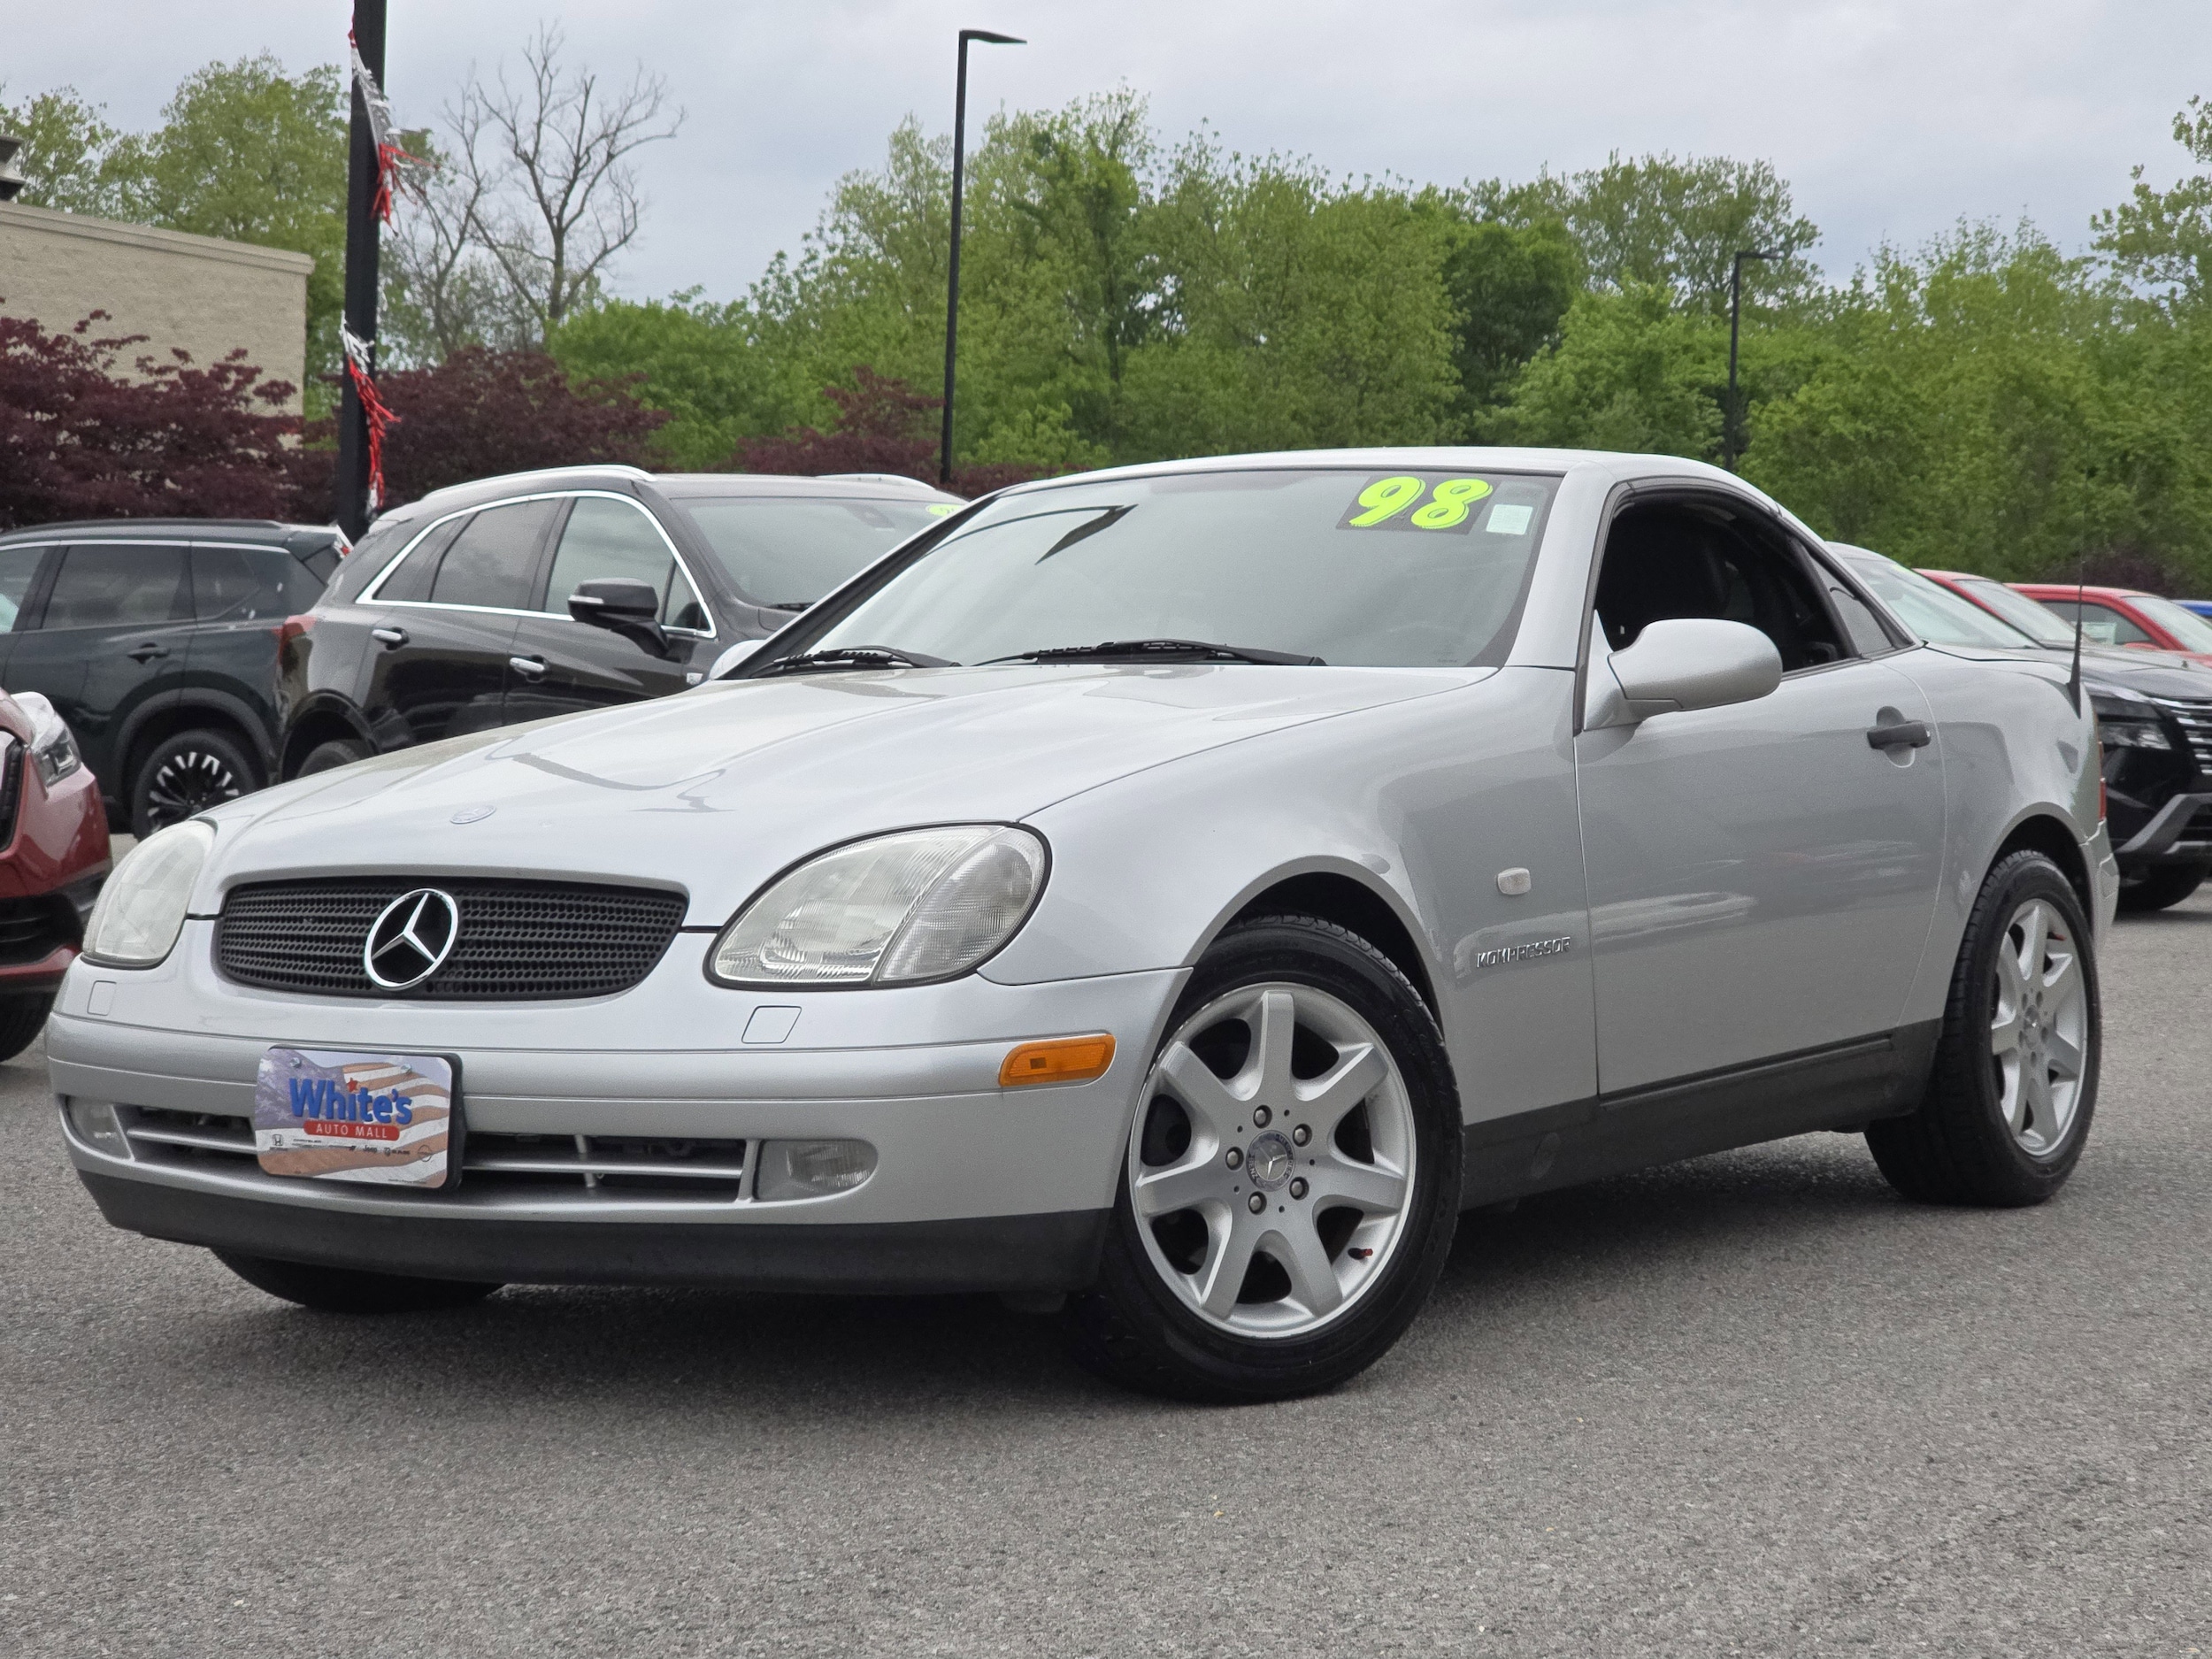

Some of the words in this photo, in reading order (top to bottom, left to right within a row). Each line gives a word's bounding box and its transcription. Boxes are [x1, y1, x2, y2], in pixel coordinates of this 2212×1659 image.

[1348, 475, 1494, 529] 98
[1476, 936, 1571, 968] KOMPRESSOR
[288, 1077, 413, 1125] White's
[316, 1123, 349, 1136] AUTO
[355, 1125, 388, 1139] MALL
